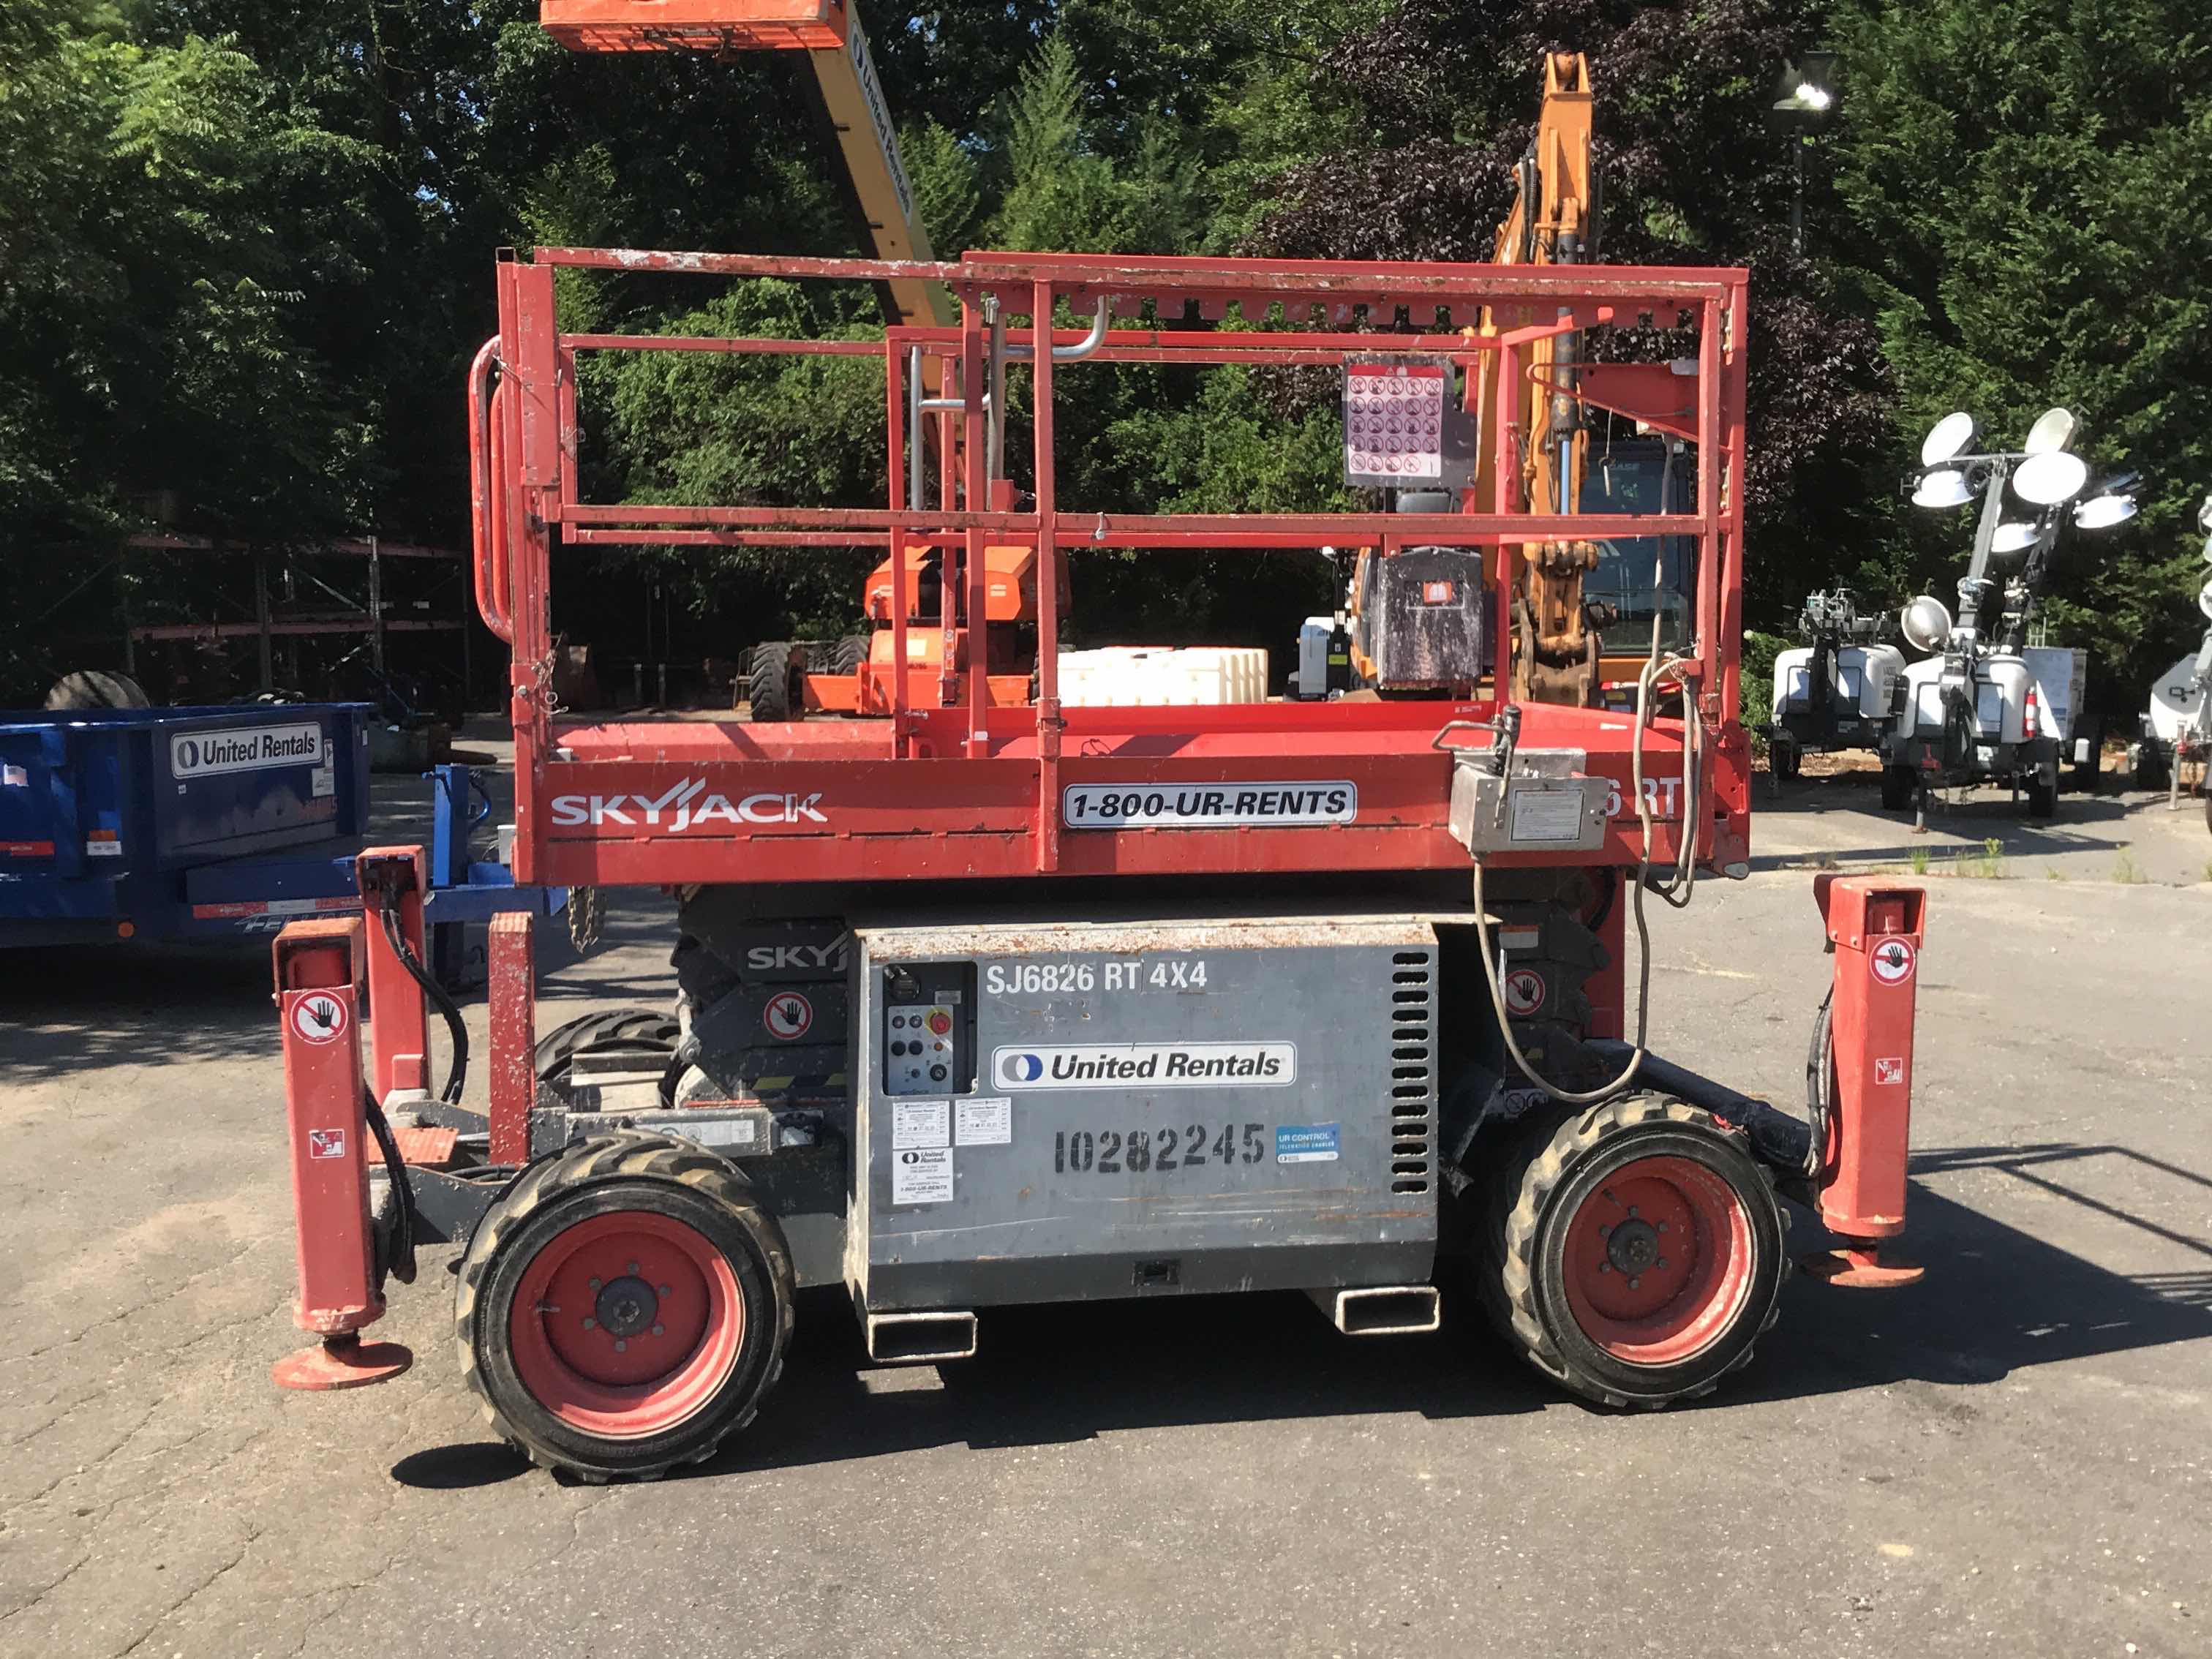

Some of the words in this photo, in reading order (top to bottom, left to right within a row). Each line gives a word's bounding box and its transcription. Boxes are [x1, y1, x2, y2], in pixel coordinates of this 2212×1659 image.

[862, 65, 887, 140] United
[884, 137, 911, 214] Rentals
[203, 735, 258, 765] United
[261, 731, 315, 759] Rentals
[551, 776, 829, 832] SKYJACK
[1072, 789, 1347, 819] 1-800-UR-RENTS
[1634, 777, 1682, 816] RT
[986, 963, 1095, 995] SJ6826
[1105, 962, 1141, 990] RT
[1149, 960, 1208, 988] 4X4
[1050, 1053, 1159, 1080] United
[1165, 1051, 1281, 1079] Rentals
[1055, 1124, 1265, 1174] 10282245
[1292, 1132, 1330, 1141] CONTROL
